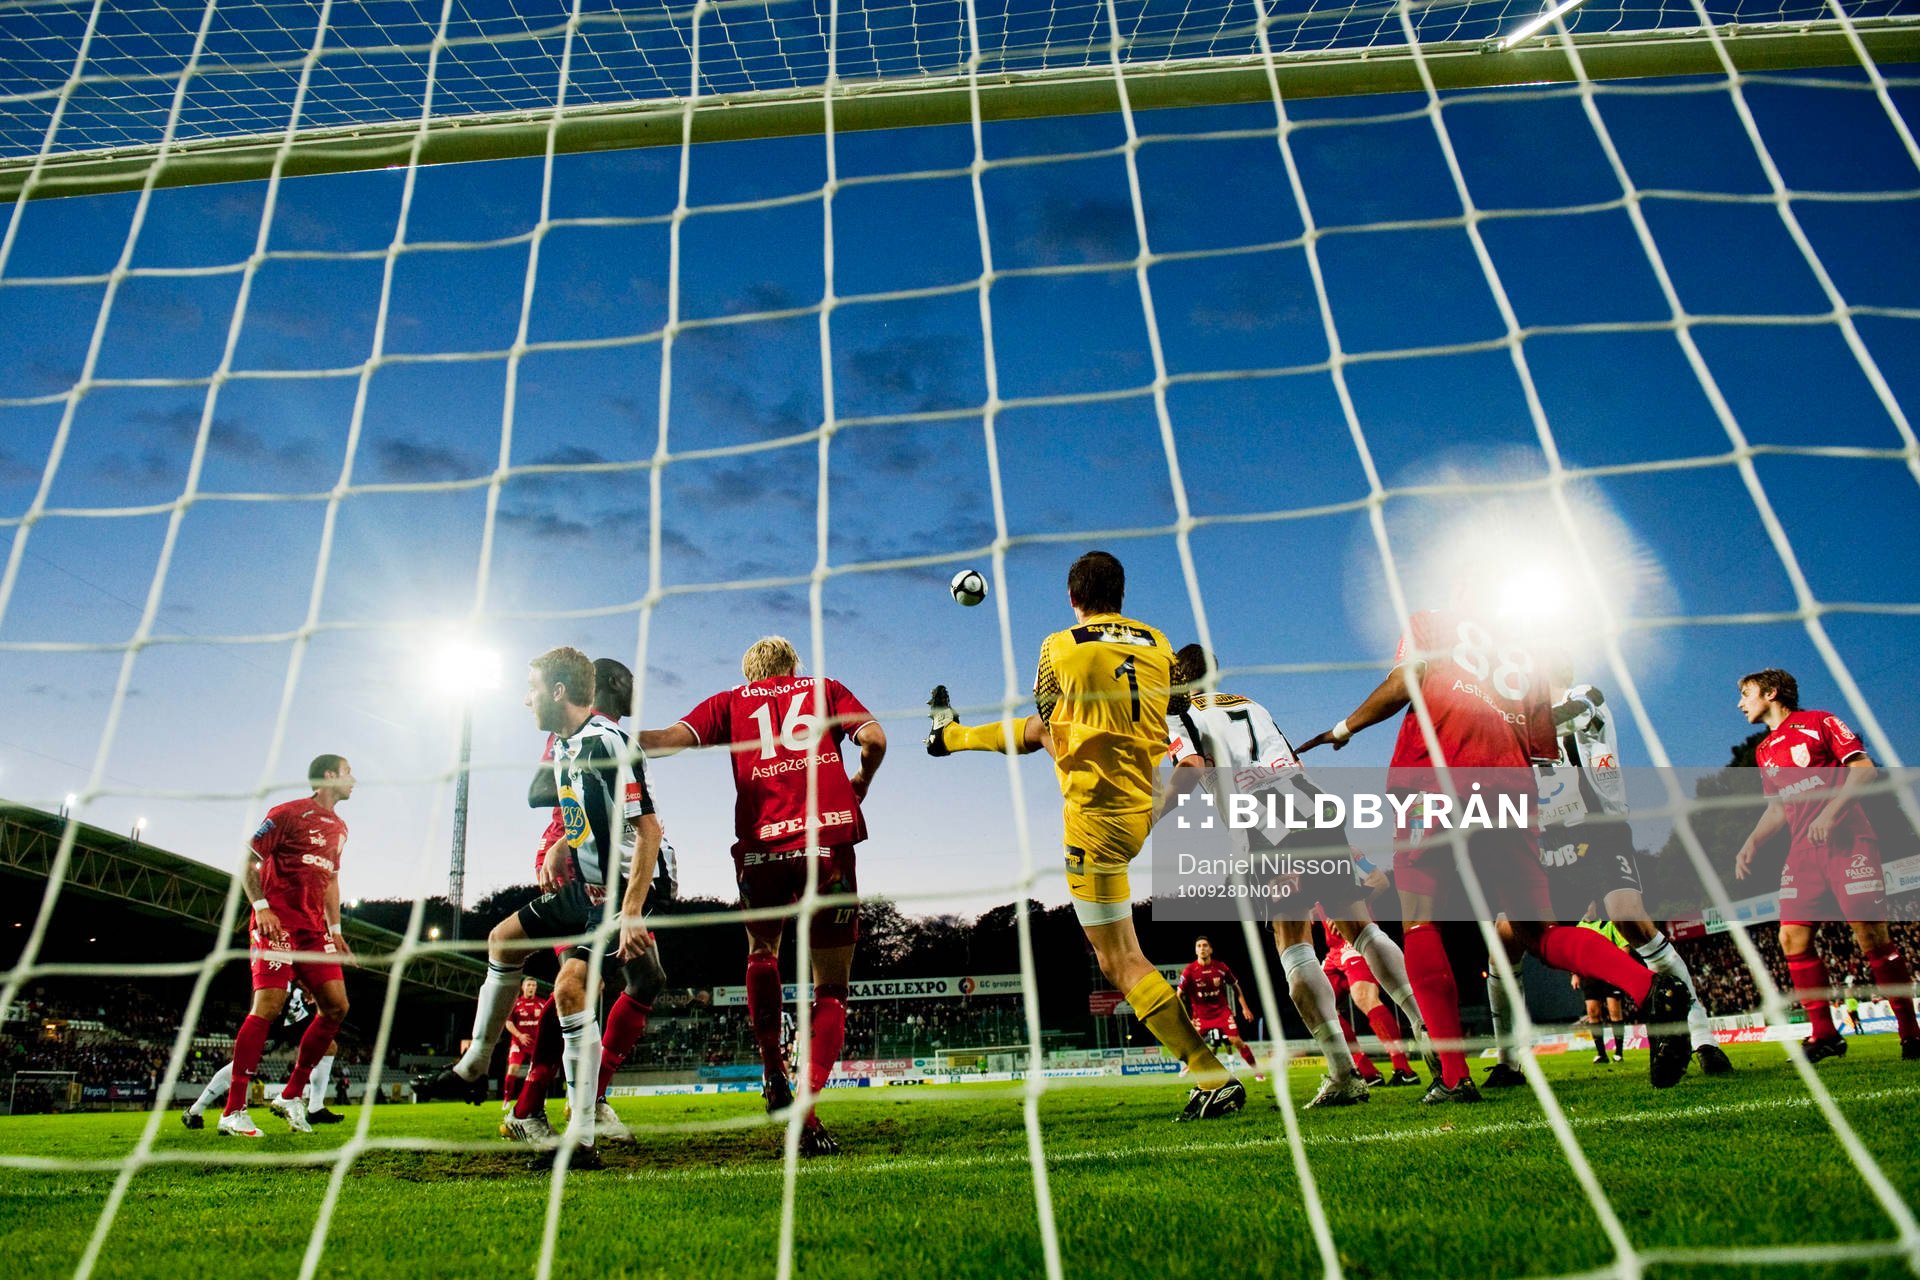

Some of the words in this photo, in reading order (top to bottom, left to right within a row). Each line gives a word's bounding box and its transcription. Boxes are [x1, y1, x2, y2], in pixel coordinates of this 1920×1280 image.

[1114, 655, 1140, 722] 1
[748, 691, 820, 761] 16
[1225, 709, 1259, 763] 7
[765, 811, 845, 837] PEAB
[1615, 855, 1632, 874] 3
[268, 960, 282, 971] 99
[849, 980, 948, 997] KAKELEXPO
[871, 1061, 906, 1070] umbro
[923, 1066, 976, 1076] SKANSKA
